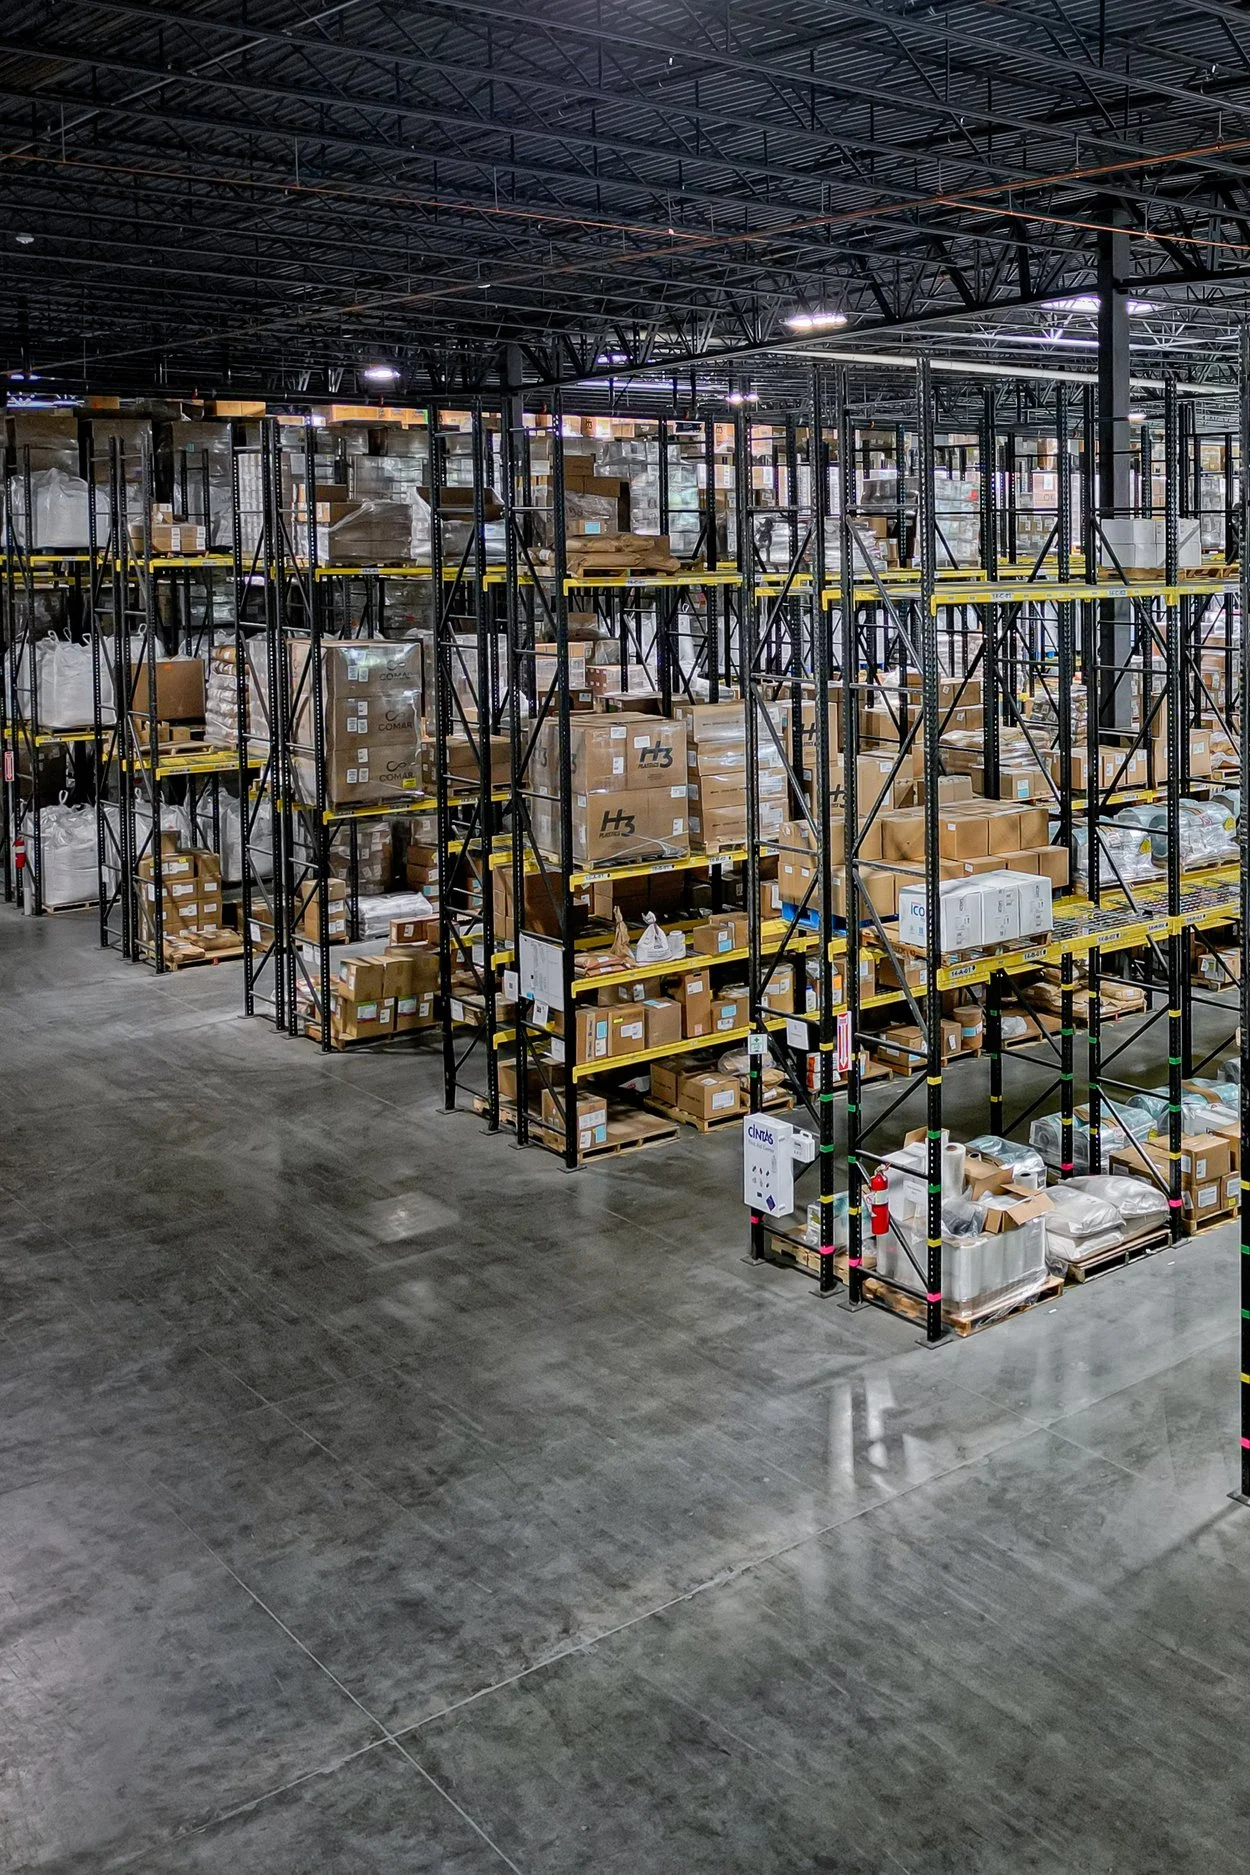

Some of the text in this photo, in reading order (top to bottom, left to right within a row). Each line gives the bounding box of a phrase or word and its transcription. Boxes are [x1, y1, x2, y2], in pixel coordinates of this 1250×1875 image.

[379, 722, 413, 732] COMAR
[640, 741, 673, 769] H3
[380, 772, 415, 783] COMAR
[600, 809, 635, 837] H3
[951, 967, 971, 977] 14-A-01
